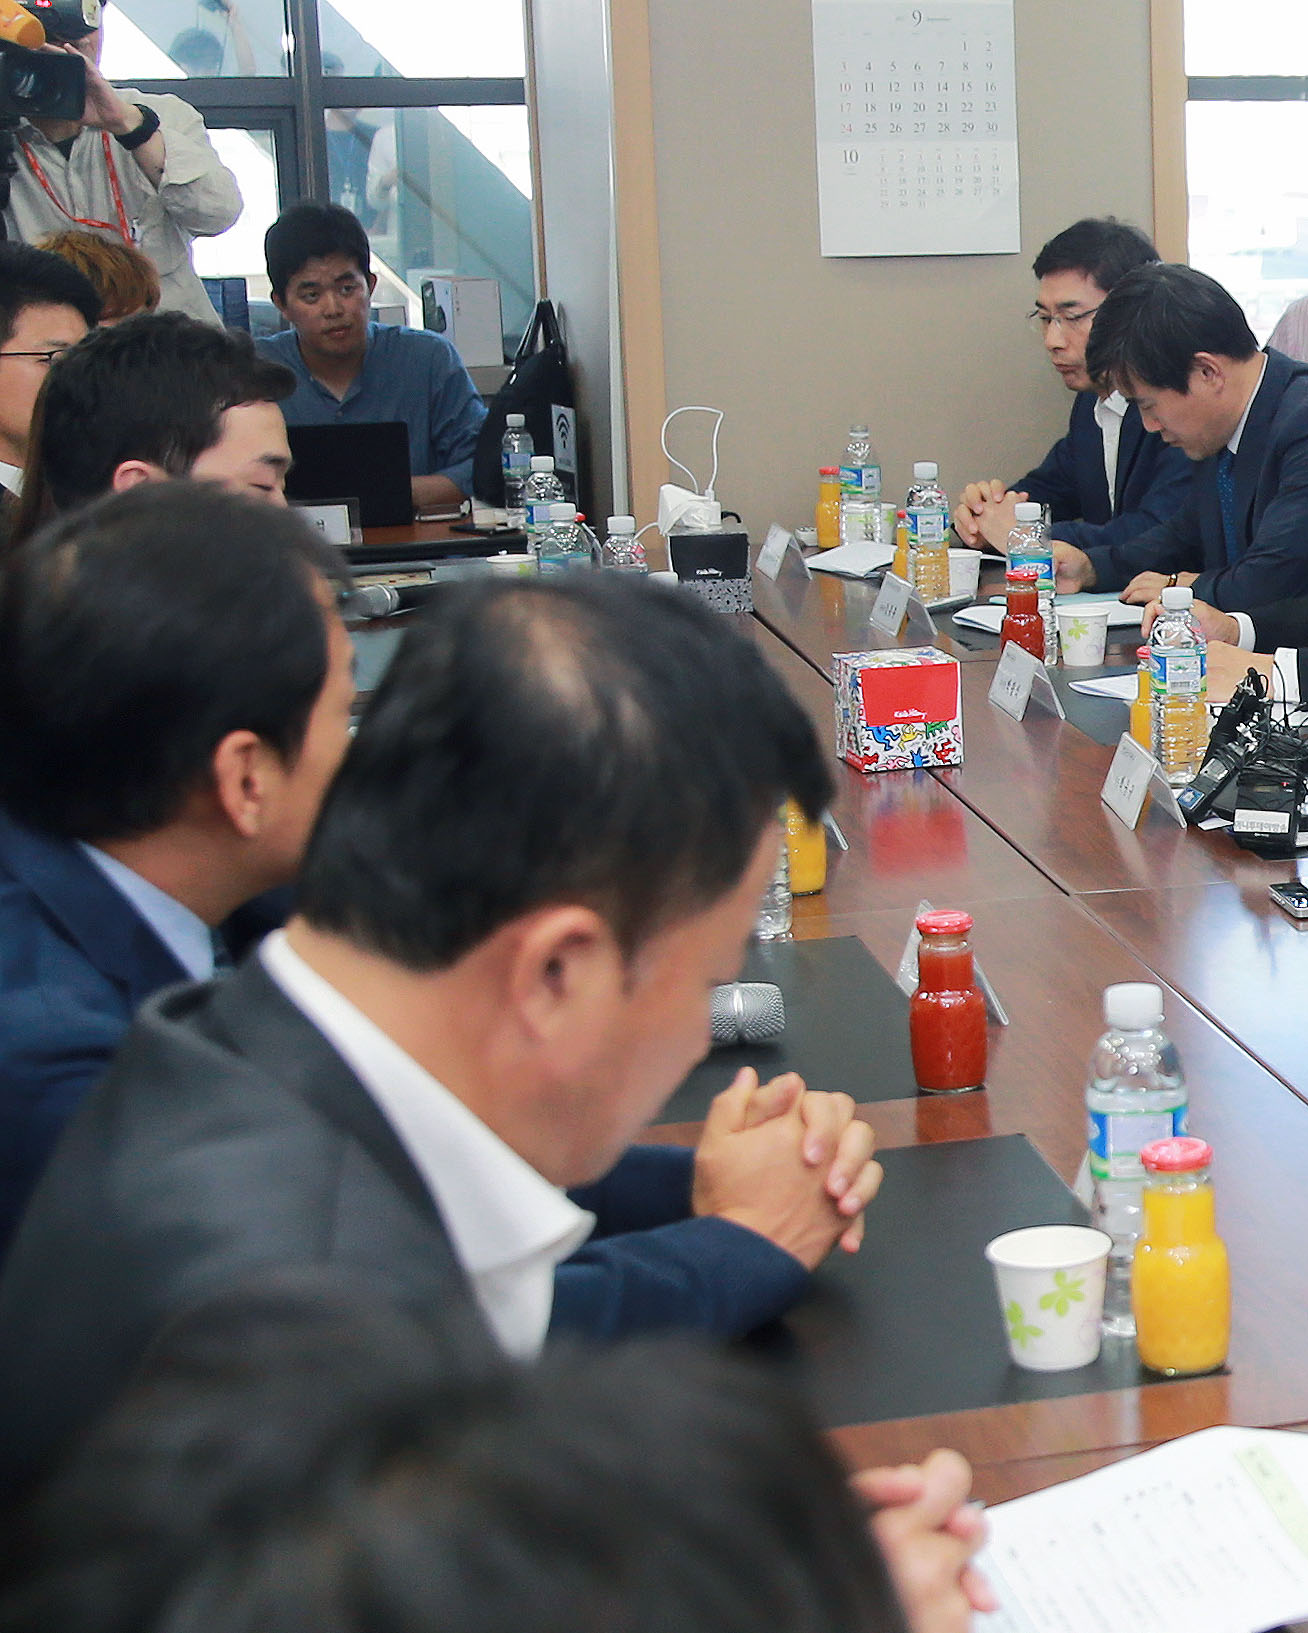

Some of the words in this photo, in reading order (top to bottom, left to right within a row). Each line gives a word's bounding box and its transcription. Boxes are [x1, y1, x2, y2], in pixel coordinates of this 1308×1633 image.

[912, 10, 922, 26] 9
[985, 41, 992, 51] 2
[865, 62, 872, 72] 4
[890, 62, 897, 72] 5
[914, 62, 921, 72] 6
[938, 62, 945, 72] 7
[962, 62, 969, 72] 8
[985, 62, 992, 72] 9
[840, 82, 851, 92] 10
[865, 82, 875, 92] 11
[889, 82, 900, 92] 12
[913, 82, 924, 92] 13
[937, 82, 948, 92] 14
[961, 82, 972, 92] 15
[985, 82, 996, 92] 16
[840, 102, 851, 112] 17
[865, 102, 877, 112] 18
[890, 102, 901, 112] 19
[914, 102, 925, 112] 20
[937, 102, 948, 112] 21
[961, 102, 973, 112] 22
[985, 102, 996, 112] 23
[865, 123, 877, 133] 25
[890, 123, 902, 133] 26
[914, 123, 926, 133] 27
[938, 123, 950, 133] 28
[962, 123, 974, 133] 29
[986, 123, 998, 133] 30
[843, 150, 859, 164] 10
